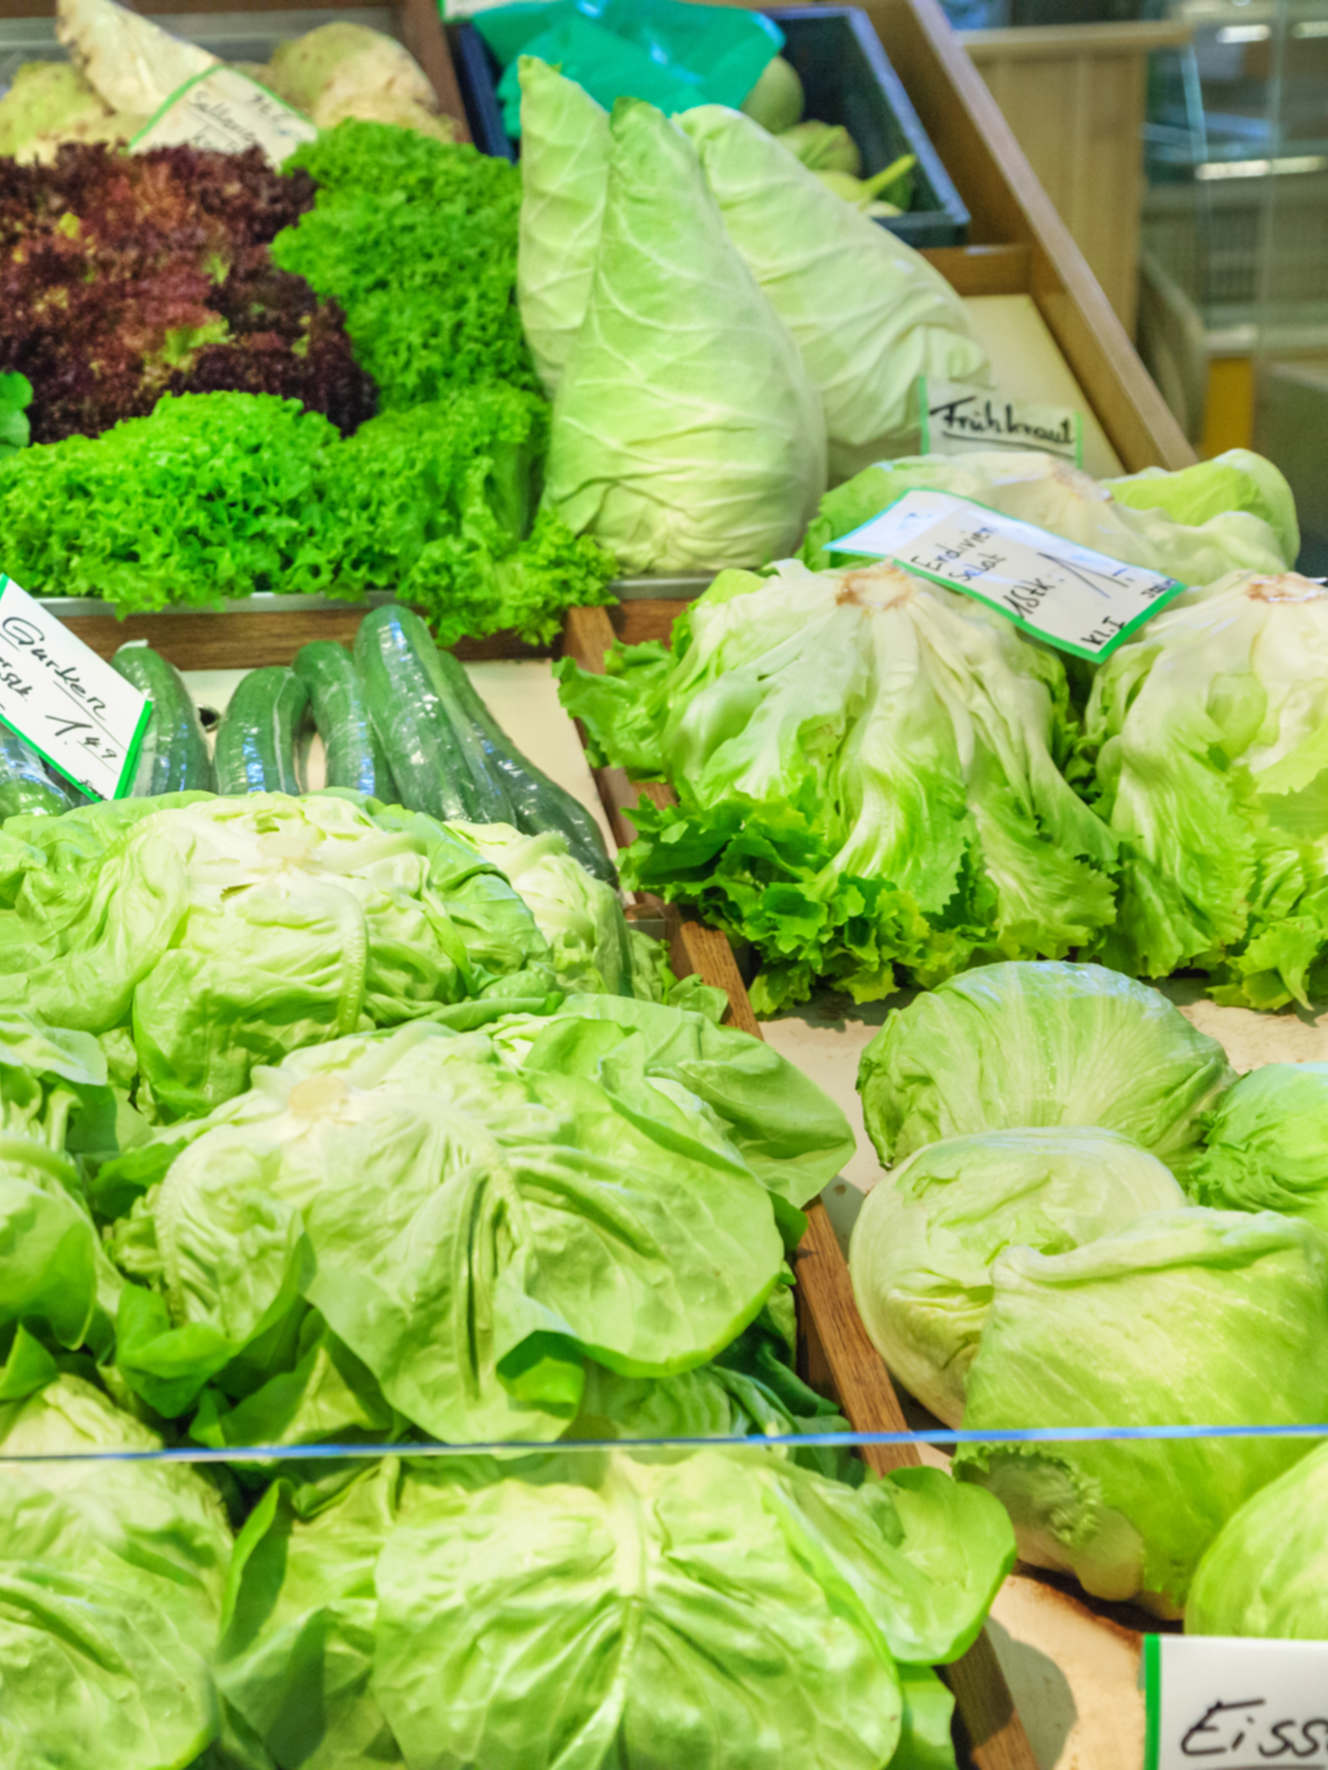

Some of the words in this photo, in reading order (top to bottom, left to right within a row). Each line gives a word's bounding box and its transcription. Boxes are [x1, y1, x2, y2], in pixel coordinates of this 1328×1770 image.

[928, 395, 1075, 444] Frühkraut
[1, 615, 108, 722] Gurken
[1180, 1697, 1328, 1759] Eiss
